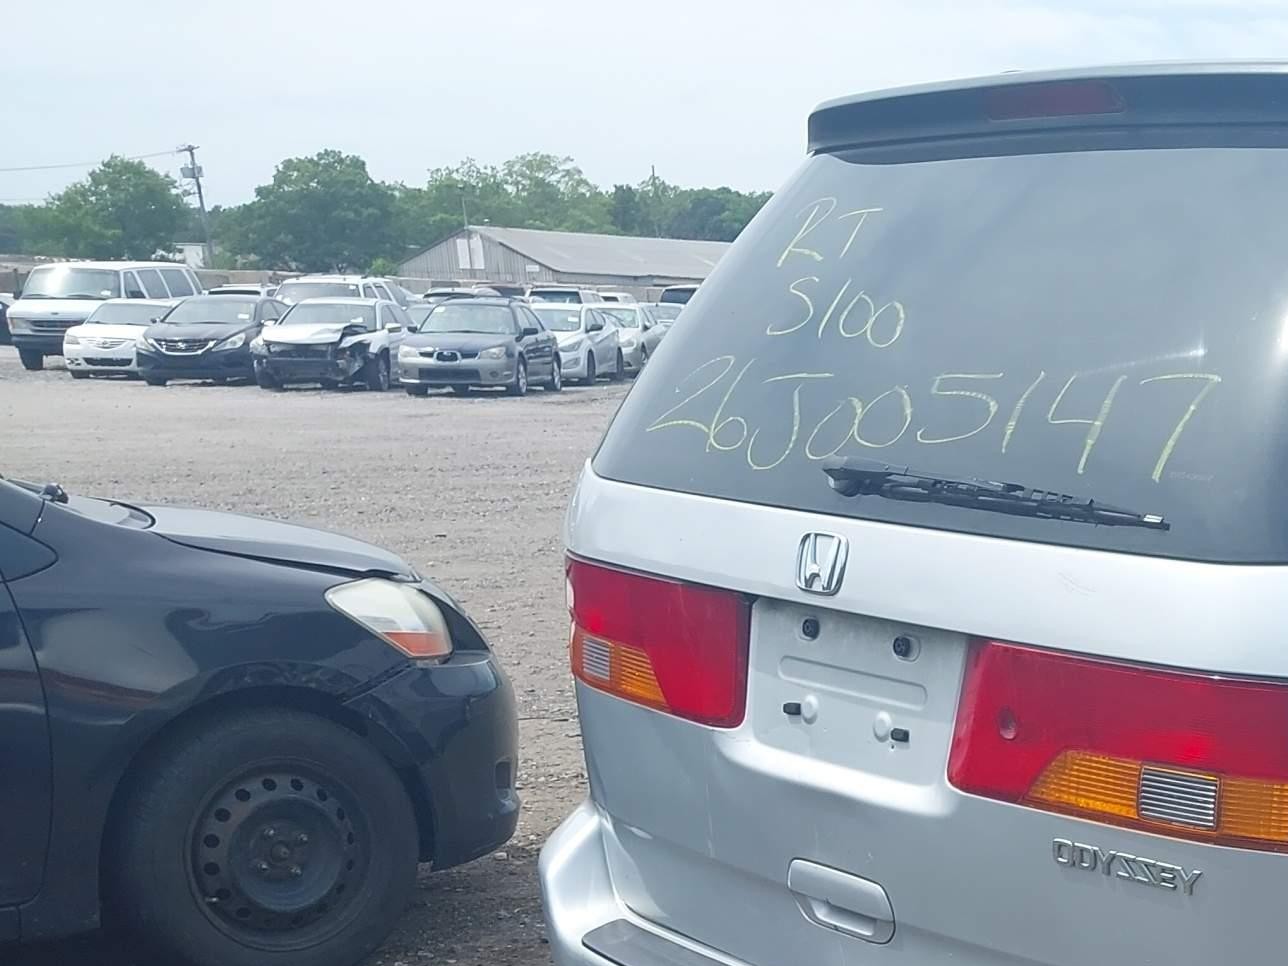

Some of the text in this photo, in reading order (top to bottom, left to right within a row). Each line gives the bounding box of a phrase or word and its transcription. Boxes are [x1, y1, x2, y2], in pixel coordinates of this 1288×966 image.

[777, 196, 884, 268] RT
[766, 275, 906, 349] S100
[646, 355, 1222, 483] 26J005147
[1052, 837, 1203, 897] ODYSSEY
